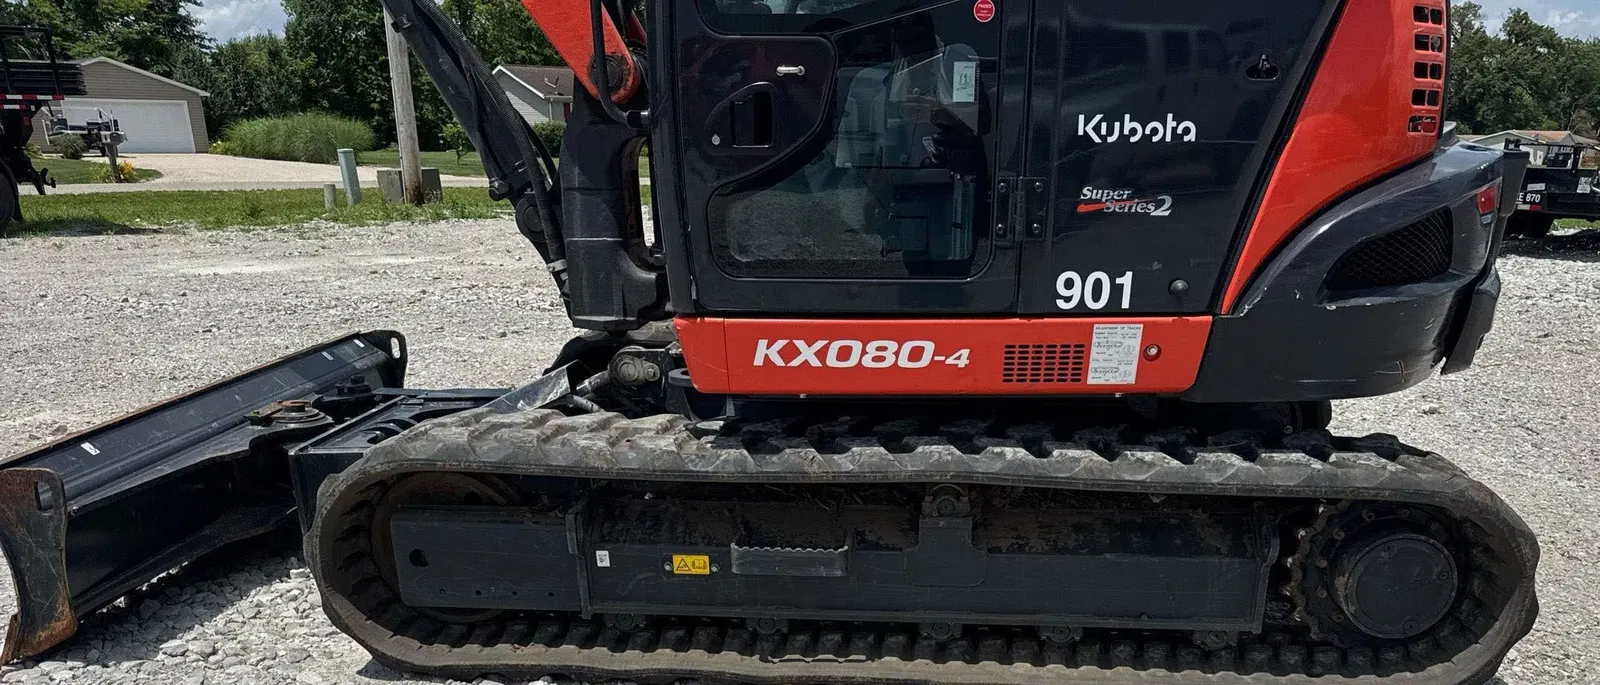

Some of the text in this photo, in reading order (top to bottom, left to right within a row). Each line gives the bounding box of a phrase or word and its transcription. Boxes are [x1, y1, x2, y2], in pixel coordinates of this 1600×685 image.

[1077, 113, 1197, 143] Kubota
[1080, 186, 1132, 202] Super
[1525, 193, 1541, 203] 870
[1055, 270, 1133, 310] 901
[753, 339, 971, 368] KX080-4
